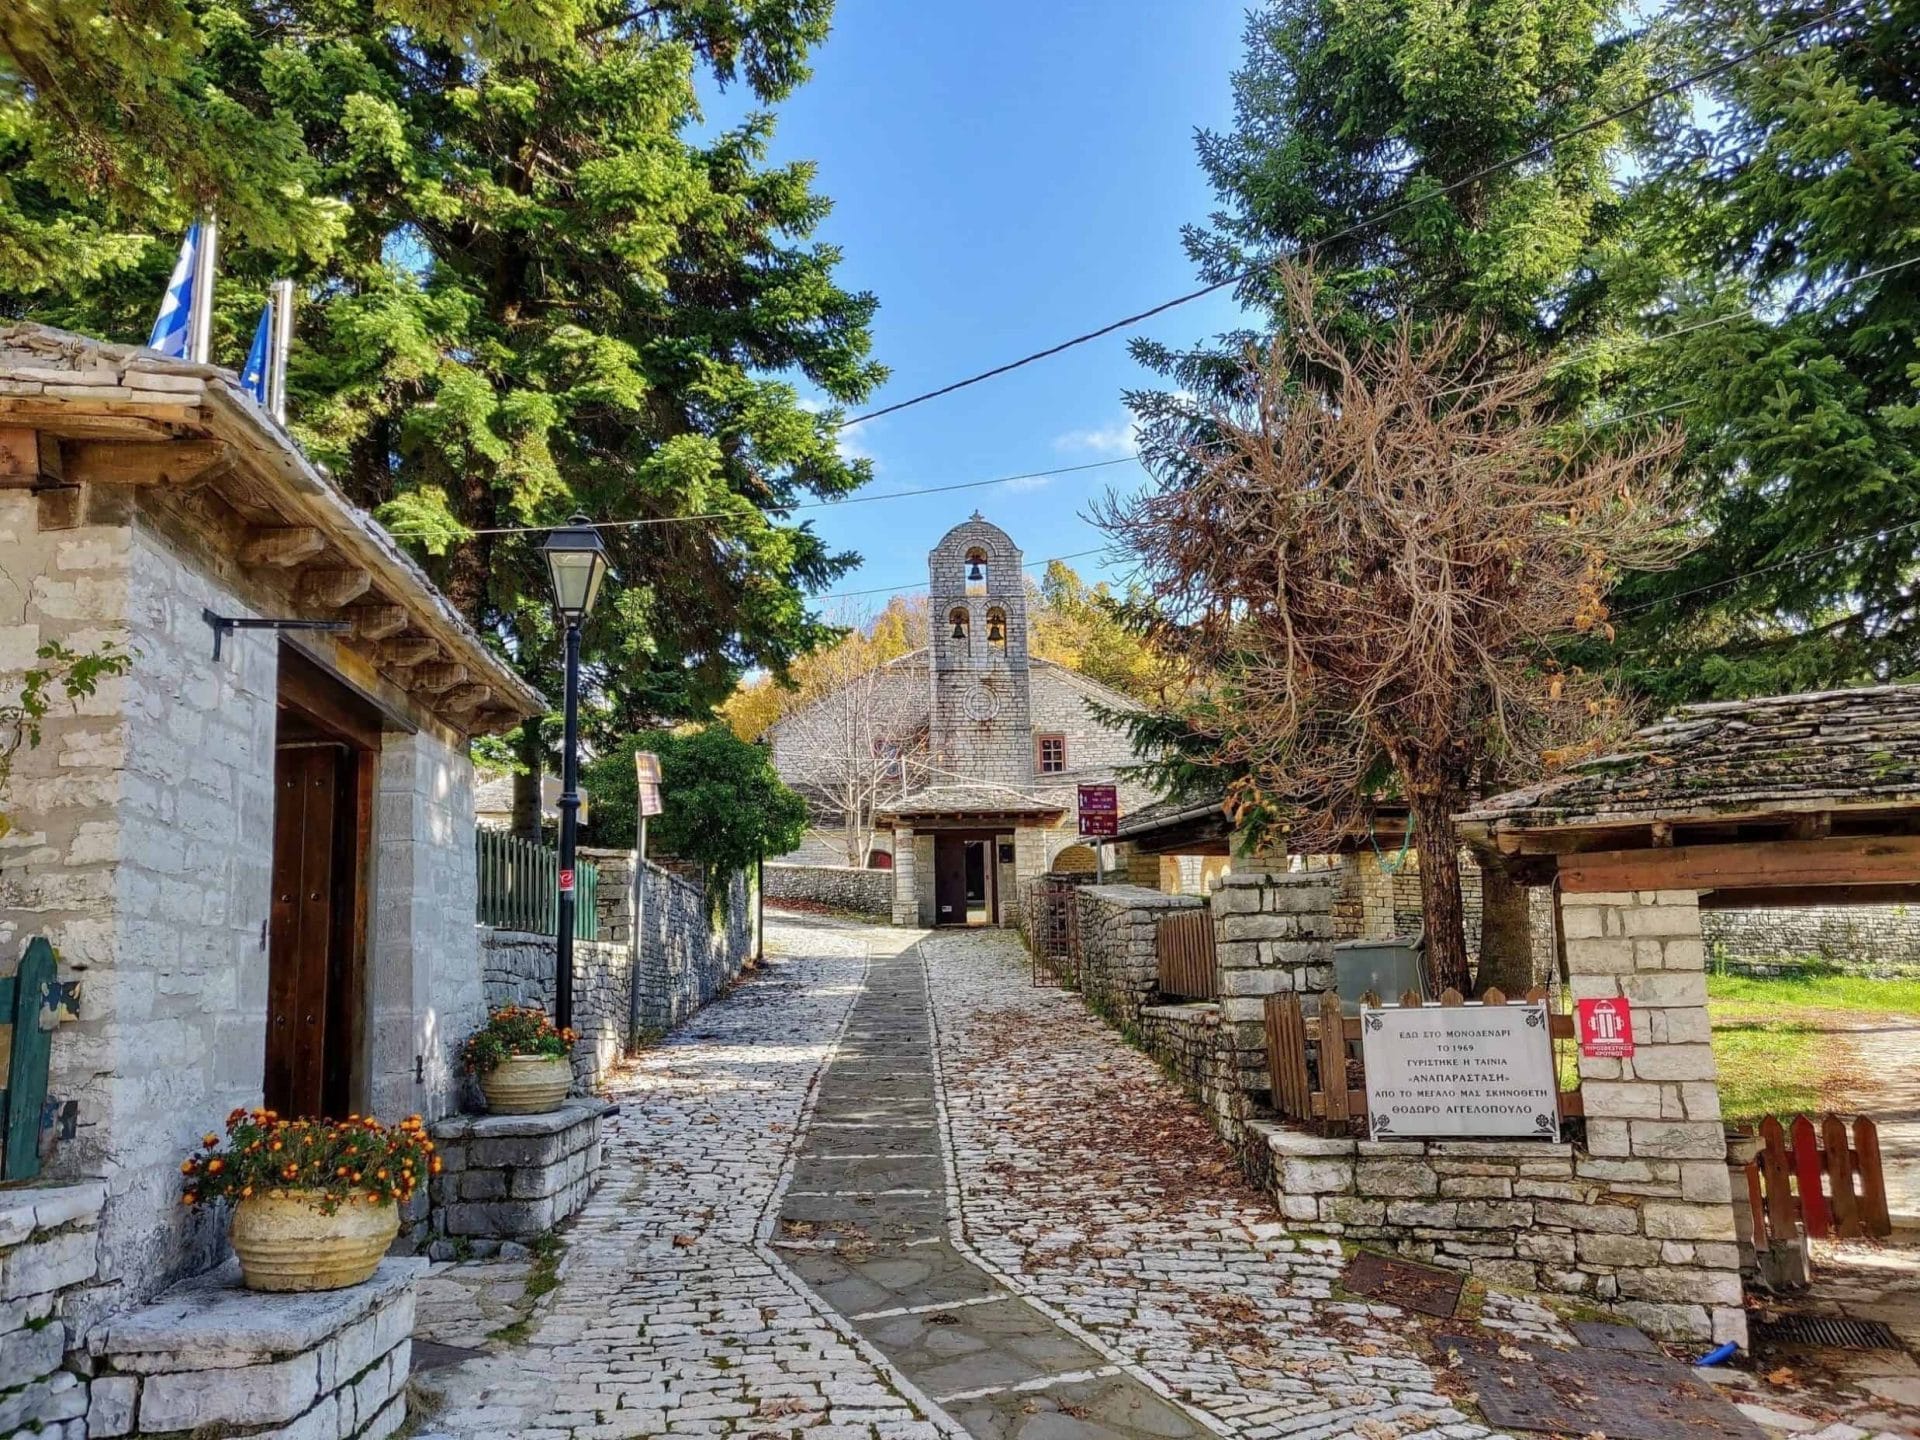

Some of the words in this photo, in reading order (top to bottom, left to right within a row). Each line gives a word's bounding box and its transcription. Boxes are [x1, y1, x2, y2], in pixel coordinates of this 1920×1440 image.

[1399, 1031, 1419, 1039] ΕΔΩ
[1423, 1030, 1442, 1039] ΣΤΟ
[1446, 1029, 1511, 1039] ΜΟΝΟΔΕΝΔΡΙ
[1436, 1044, 1450, 1052] ΤΟ
[1452, 1044, 1475, 1052] 1969
[1407, 1059, 1459, 1067] ΓΥΡΙΣΤΗΚΕ
[1463, 1058, 1471, 1066] Η
[1475, 1058, 1508, 1066] ΤΑΙΝΙΑ
[1374, 1090, 1396, 1099] ΑΠΟ
[1399, 1090, 1413, 1098] ΤΟ
[1416, 1089, 1456, 1098] ΜΕΓΑΛΟ
[1460, 1089, 1482, 1098] ΜΑΣ
[1485, 1089, 1548, 1098] ΣΚΗΝΟΘΕΤΗ
[1391, 1105, 1441, 1114] ΘΟΔΩΡΟ
[1446, 1105, 1533, 1114] ΑΓΓΕΛΟΠΟΥΛΟ
